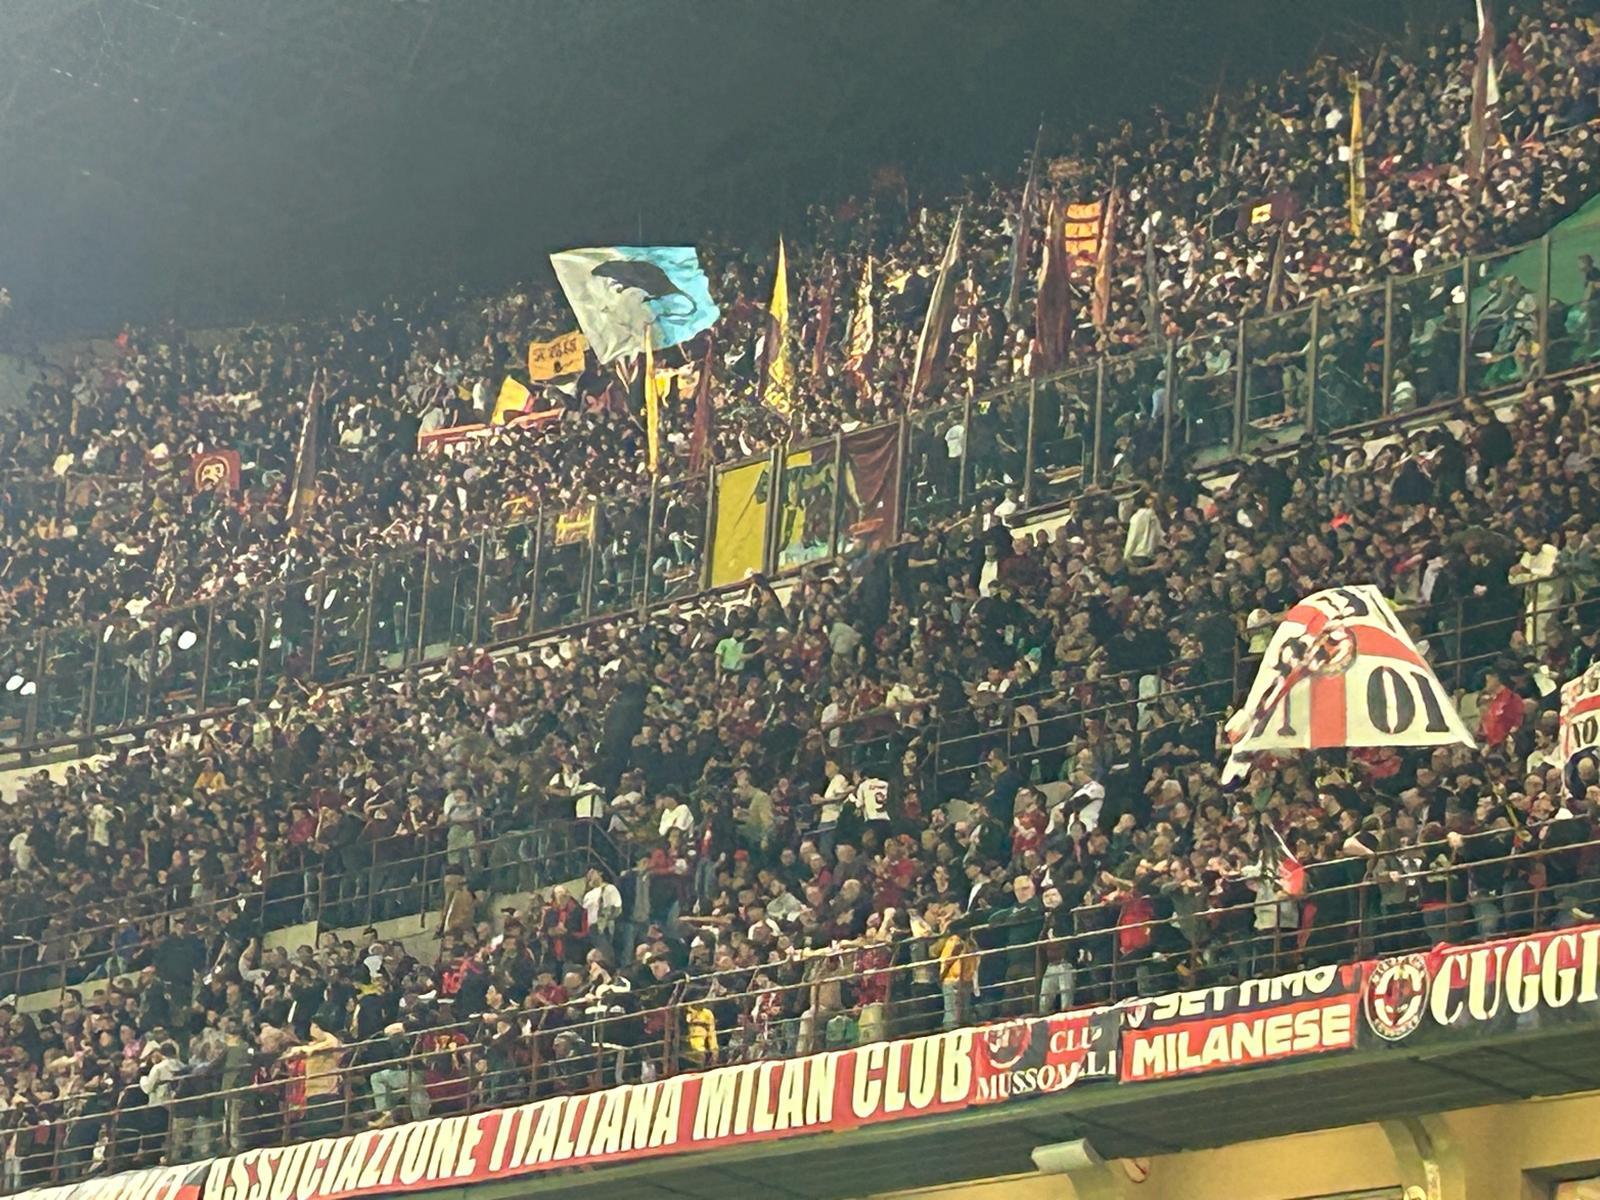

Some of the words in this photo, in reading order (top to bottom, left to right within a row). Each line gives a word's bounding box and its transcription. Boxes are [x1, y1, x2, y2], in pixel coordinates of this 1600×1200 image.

[1130, 1003, 1351, 1077] MILANESE
[203, 1113, 485, 1200] ASSOCIAZIONE
[488, 1080, 684, 1172] ITALIANA
[692, 1051, 838, 1141] MILAN
[852, 1027, 973, 1118] CLUB
